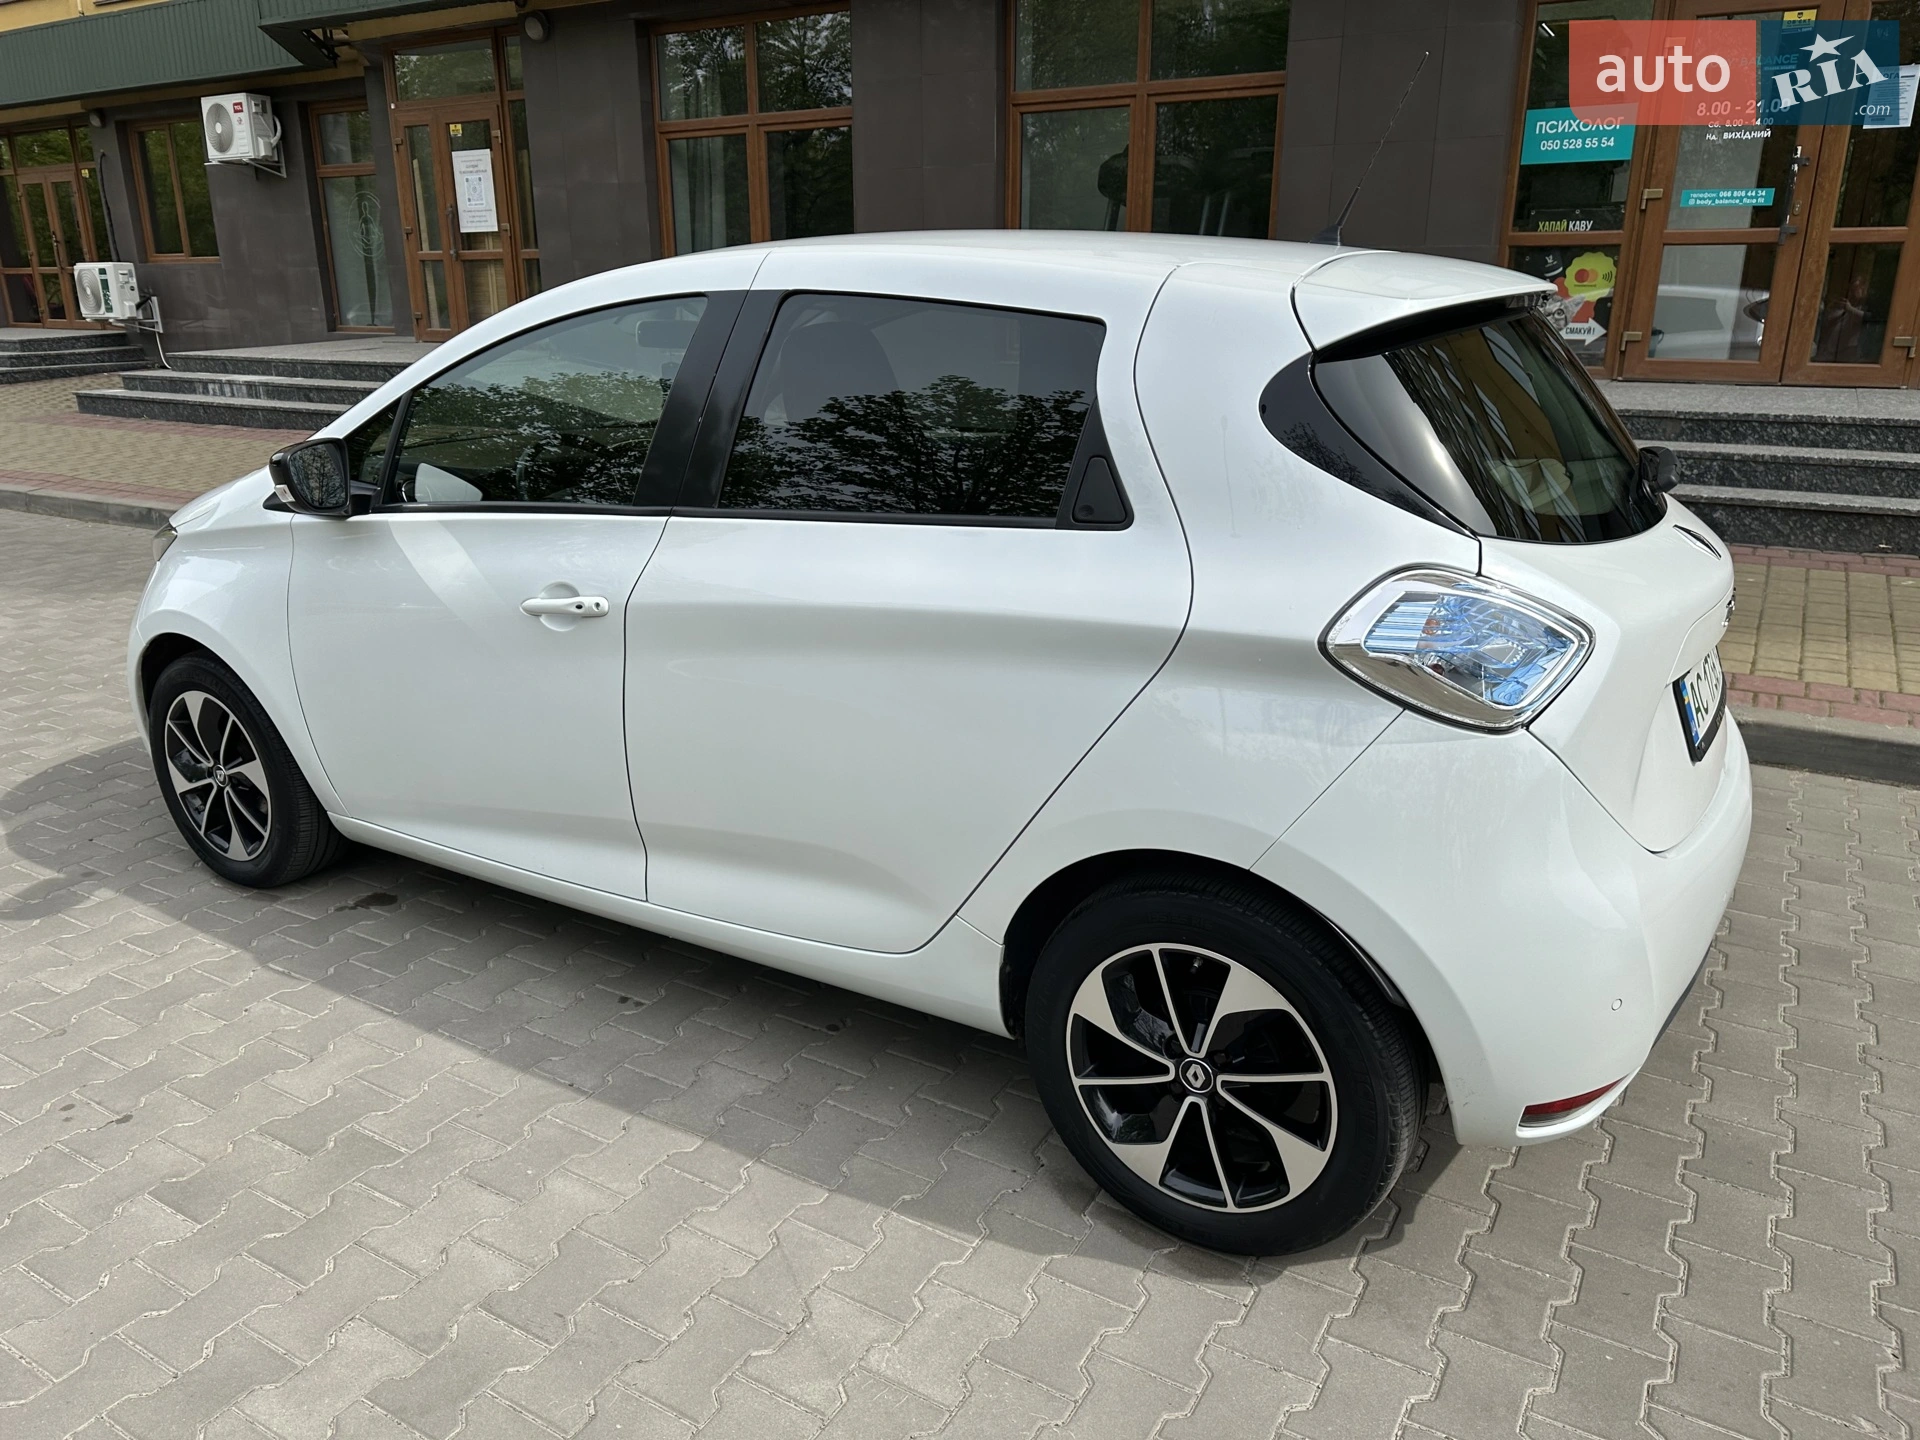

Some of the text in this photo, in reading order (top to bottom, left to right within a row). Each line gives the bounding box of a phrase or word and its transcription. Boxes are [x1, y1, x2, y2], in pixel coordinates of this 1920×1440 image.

[1696, 101, 1731, 116] 8.00
[1535, 116, 1625, 134] ПСИХОЛОГ
[1540, 136, 1614, 151] 050 528 55 54
[1537, 219, 1593, 232] ХАПАЙ КАВУ
